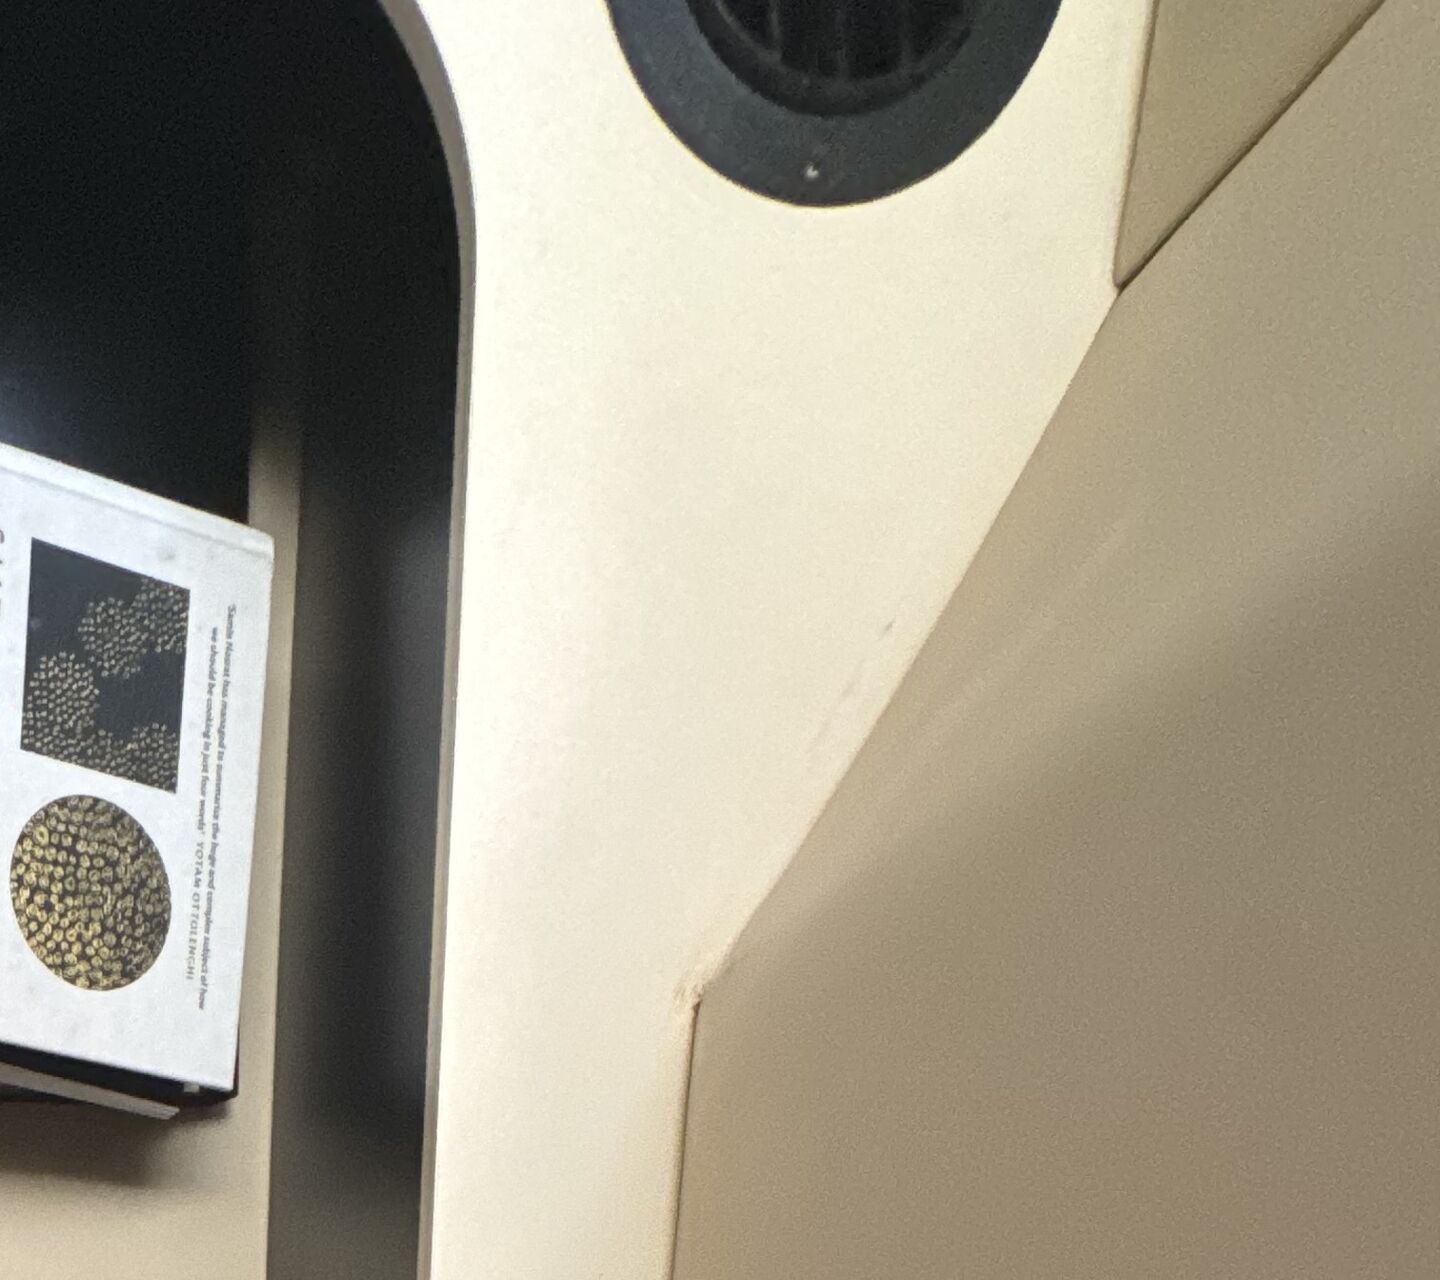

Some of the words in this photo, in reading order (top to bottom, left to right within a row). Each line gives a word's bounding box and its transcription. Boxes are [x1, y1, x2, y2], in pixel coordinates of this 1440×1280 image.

[209, 645, 219, 680] should
[222, 679, 231, 698] has
[203, 698, 214, 739] cooking
[217, 700, 228, 749] managed
[201, 752, 211, 774] just
[212, 822, 220, 839] the
[193, 841, 204, 888] YOTAM
[208, 842, 218, 868] huge
[207, 869, 216, 890] and
[200, 937, 211, 974] subject
